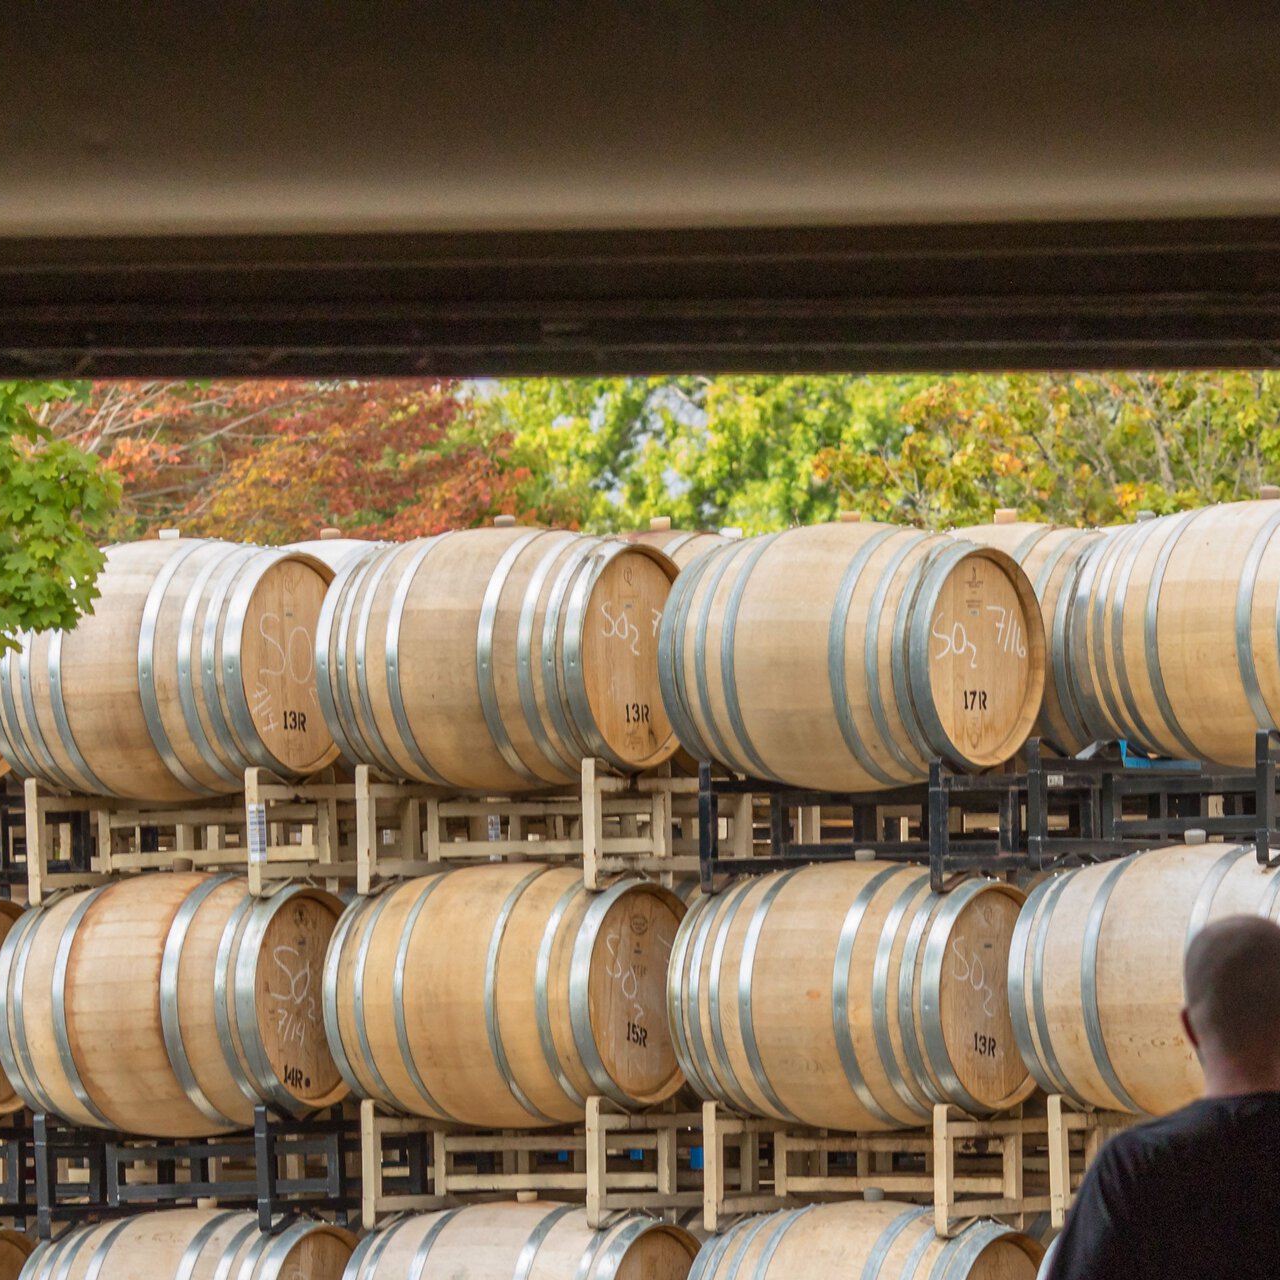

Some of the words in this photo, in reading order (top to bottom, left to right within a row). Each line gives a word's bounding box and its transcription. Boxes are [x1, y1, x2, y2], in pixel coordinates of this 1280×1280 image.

[964, 689, 988, 711] 17R
[283, 709, 307, 733] 13R
[625, 703, 650, 725] 13R
[626, 1021, 648, 1048] 15R
[973, 1031, 996, 1058] 13R
[283, 1063, 303, 1089] 14R
